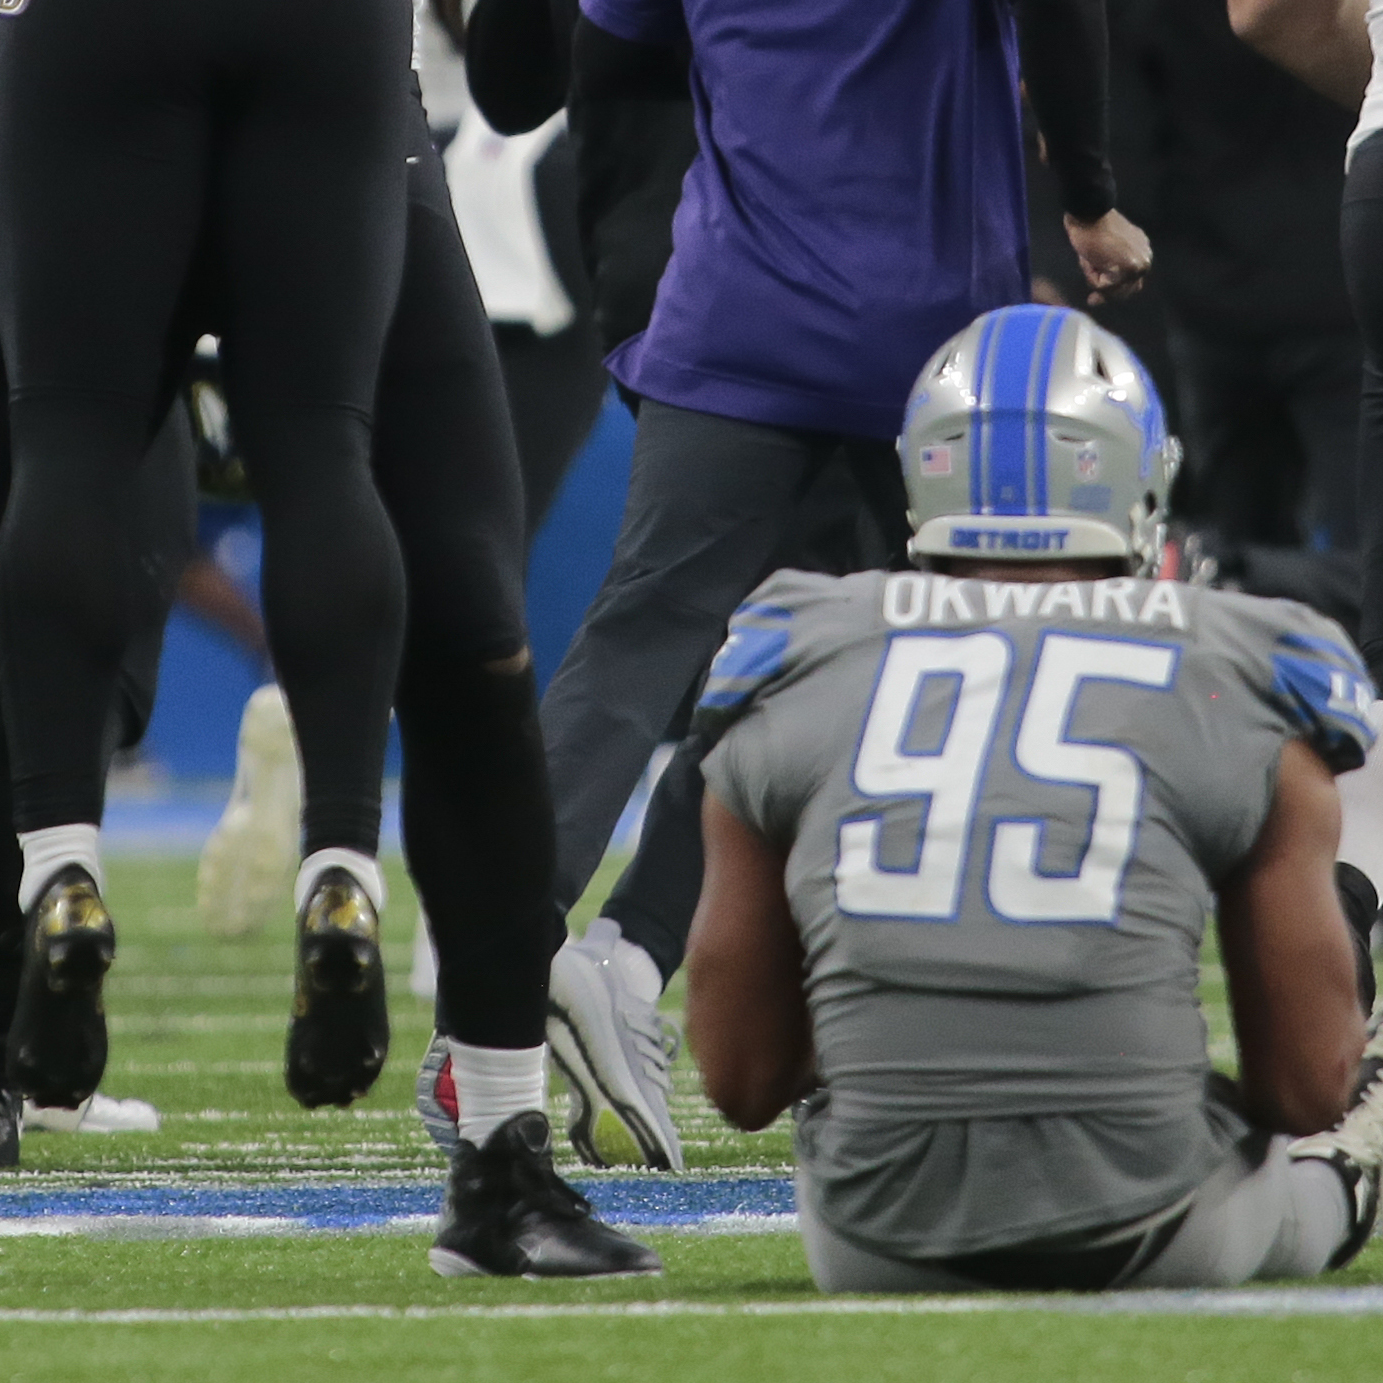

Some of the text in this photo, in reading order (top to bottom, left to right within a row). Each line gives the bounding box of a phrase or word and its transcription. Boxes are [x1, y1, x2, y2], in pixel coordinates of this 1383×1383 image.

[949, 526, 1070, 550] DETROIT
[882, 574, 1188, 631] OKWARA
[833, 627, 1184, 927] 95
